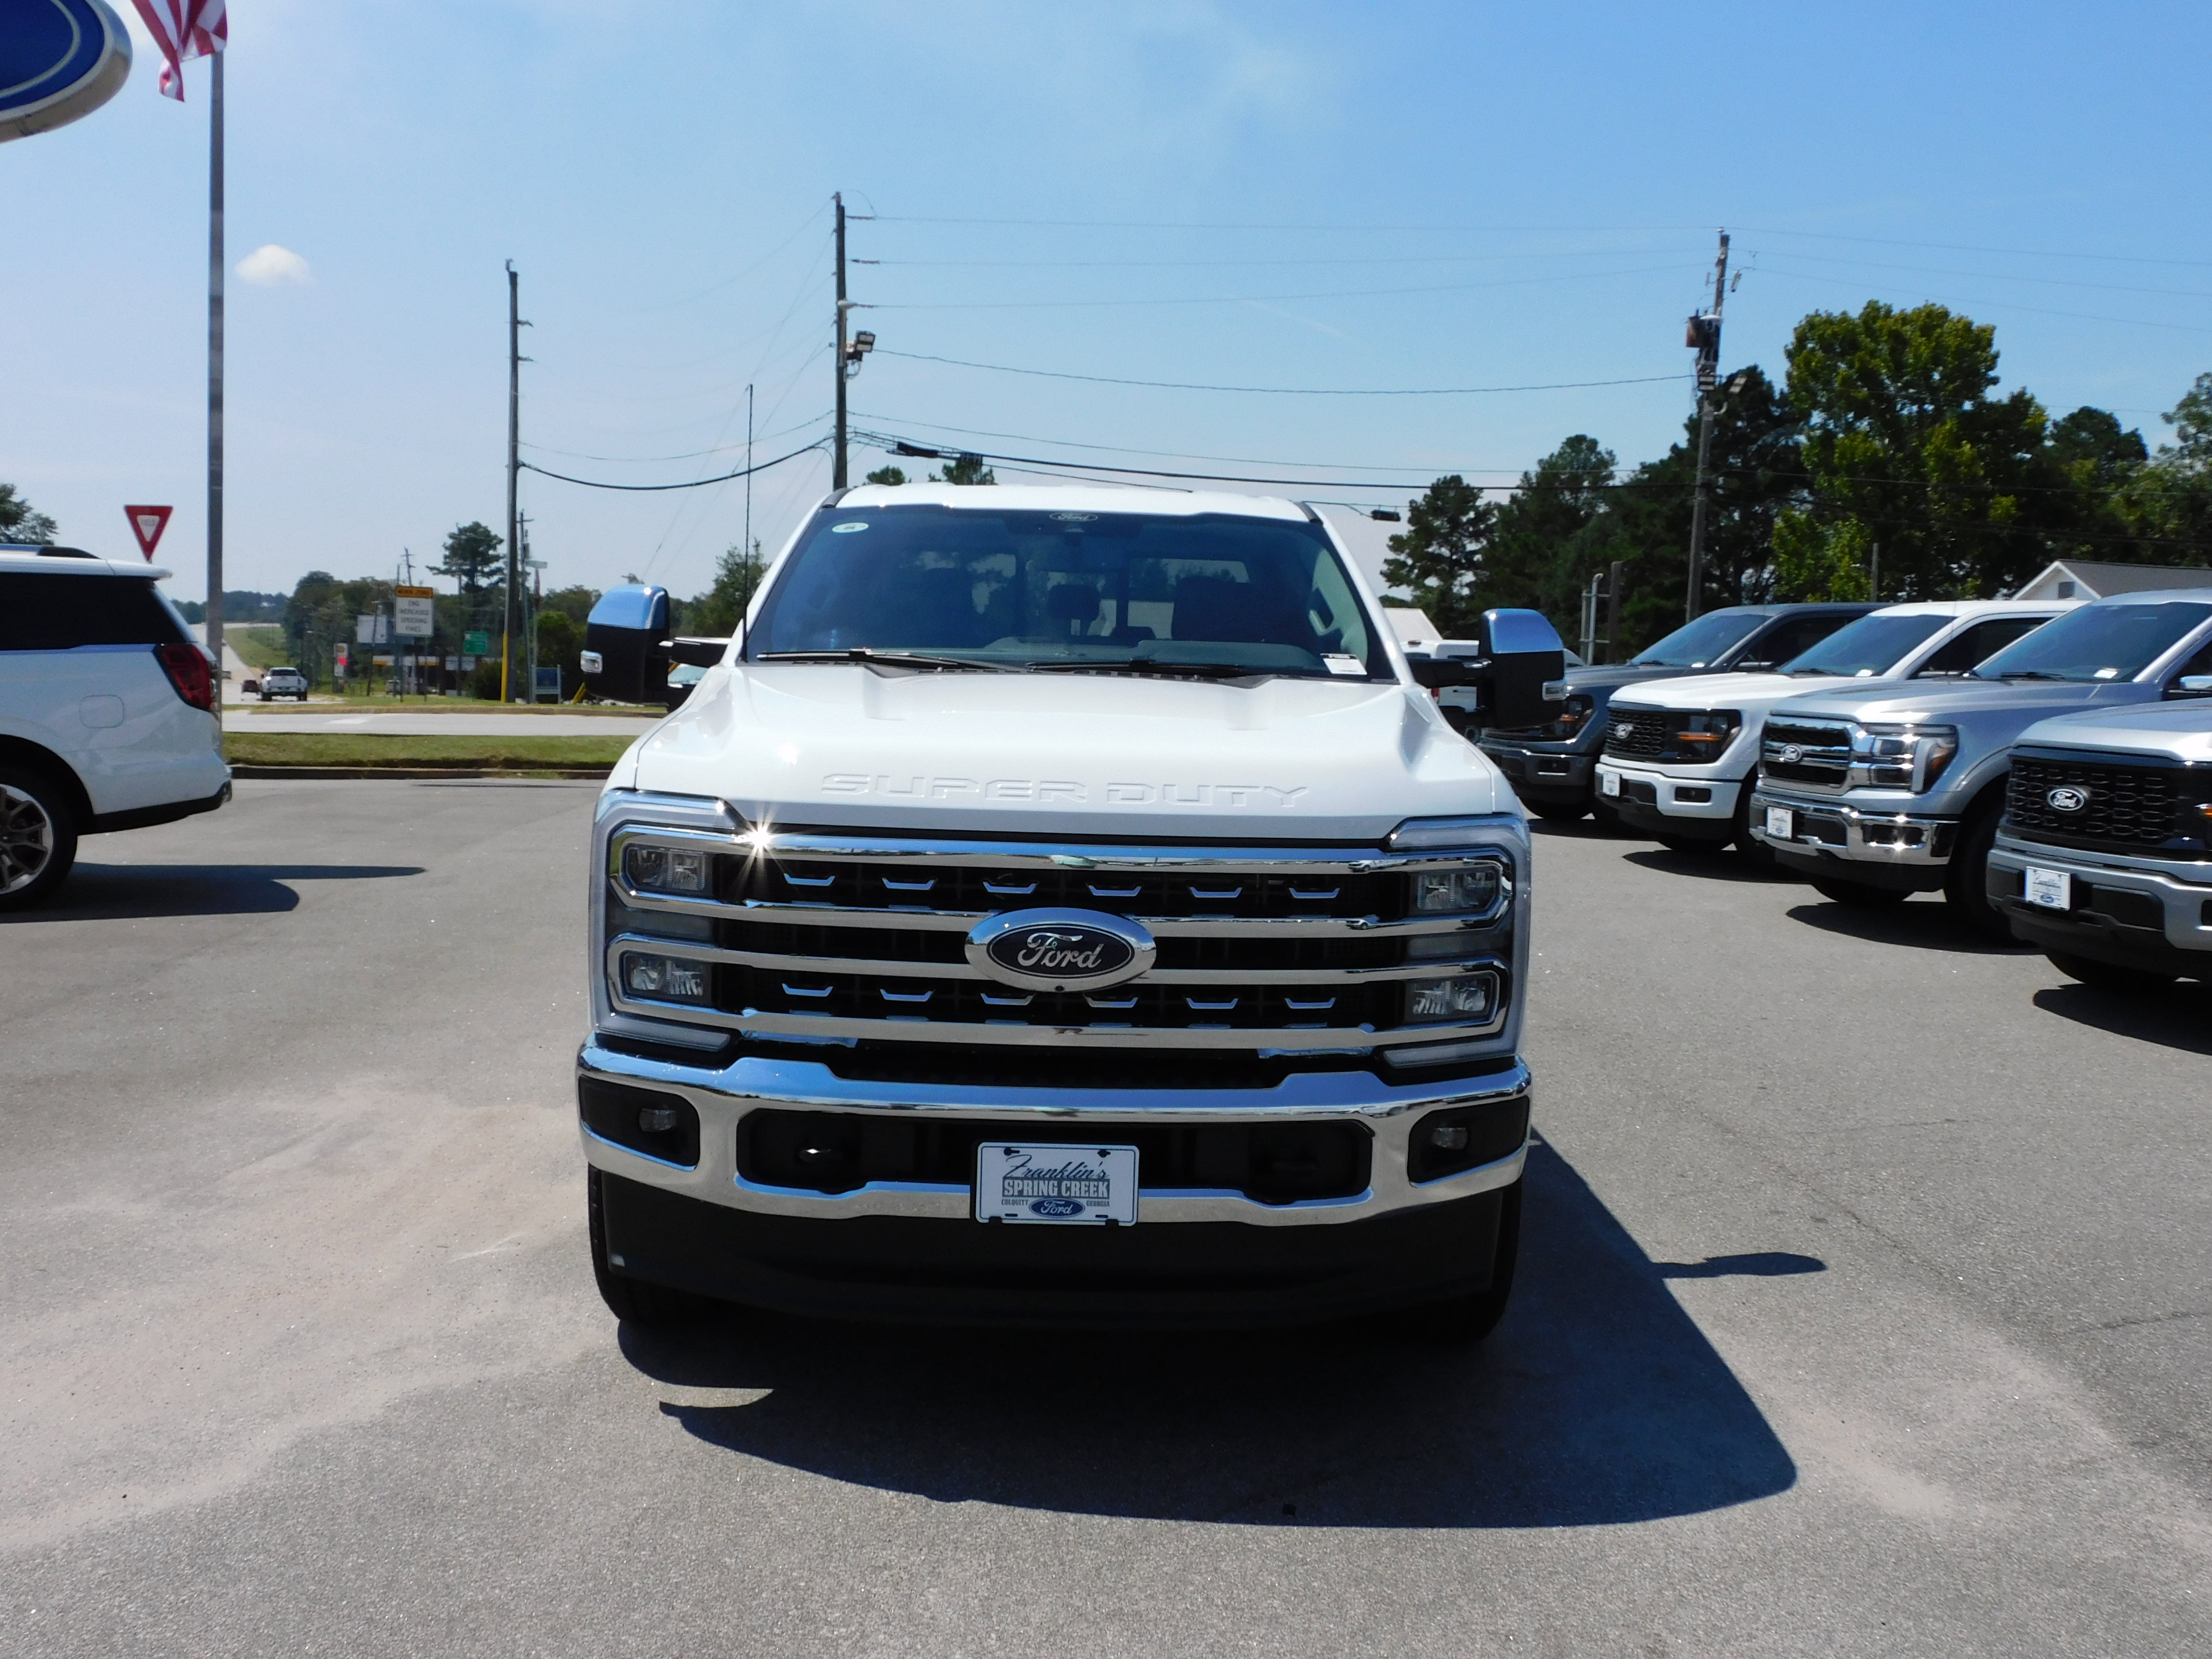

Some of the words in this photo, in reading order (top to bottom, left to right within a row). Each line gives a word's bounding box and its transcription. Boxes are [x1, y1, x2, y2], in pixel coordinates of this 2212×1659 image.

[821, 773, 1087, 803] SUPER
[1107, 782, 1310, 807] DUTY
[2053, 791, 2078, 807] Ford
[1017, 932, 1105, 968] Ford
[1003, 1154, 1110, 1179] Franklin's
[1004, 1179, 1058, 1197] SPRING
[1061, 1180, 1109, 1199] CREEK
[1040, 1201, 1073, 1214] Ford
